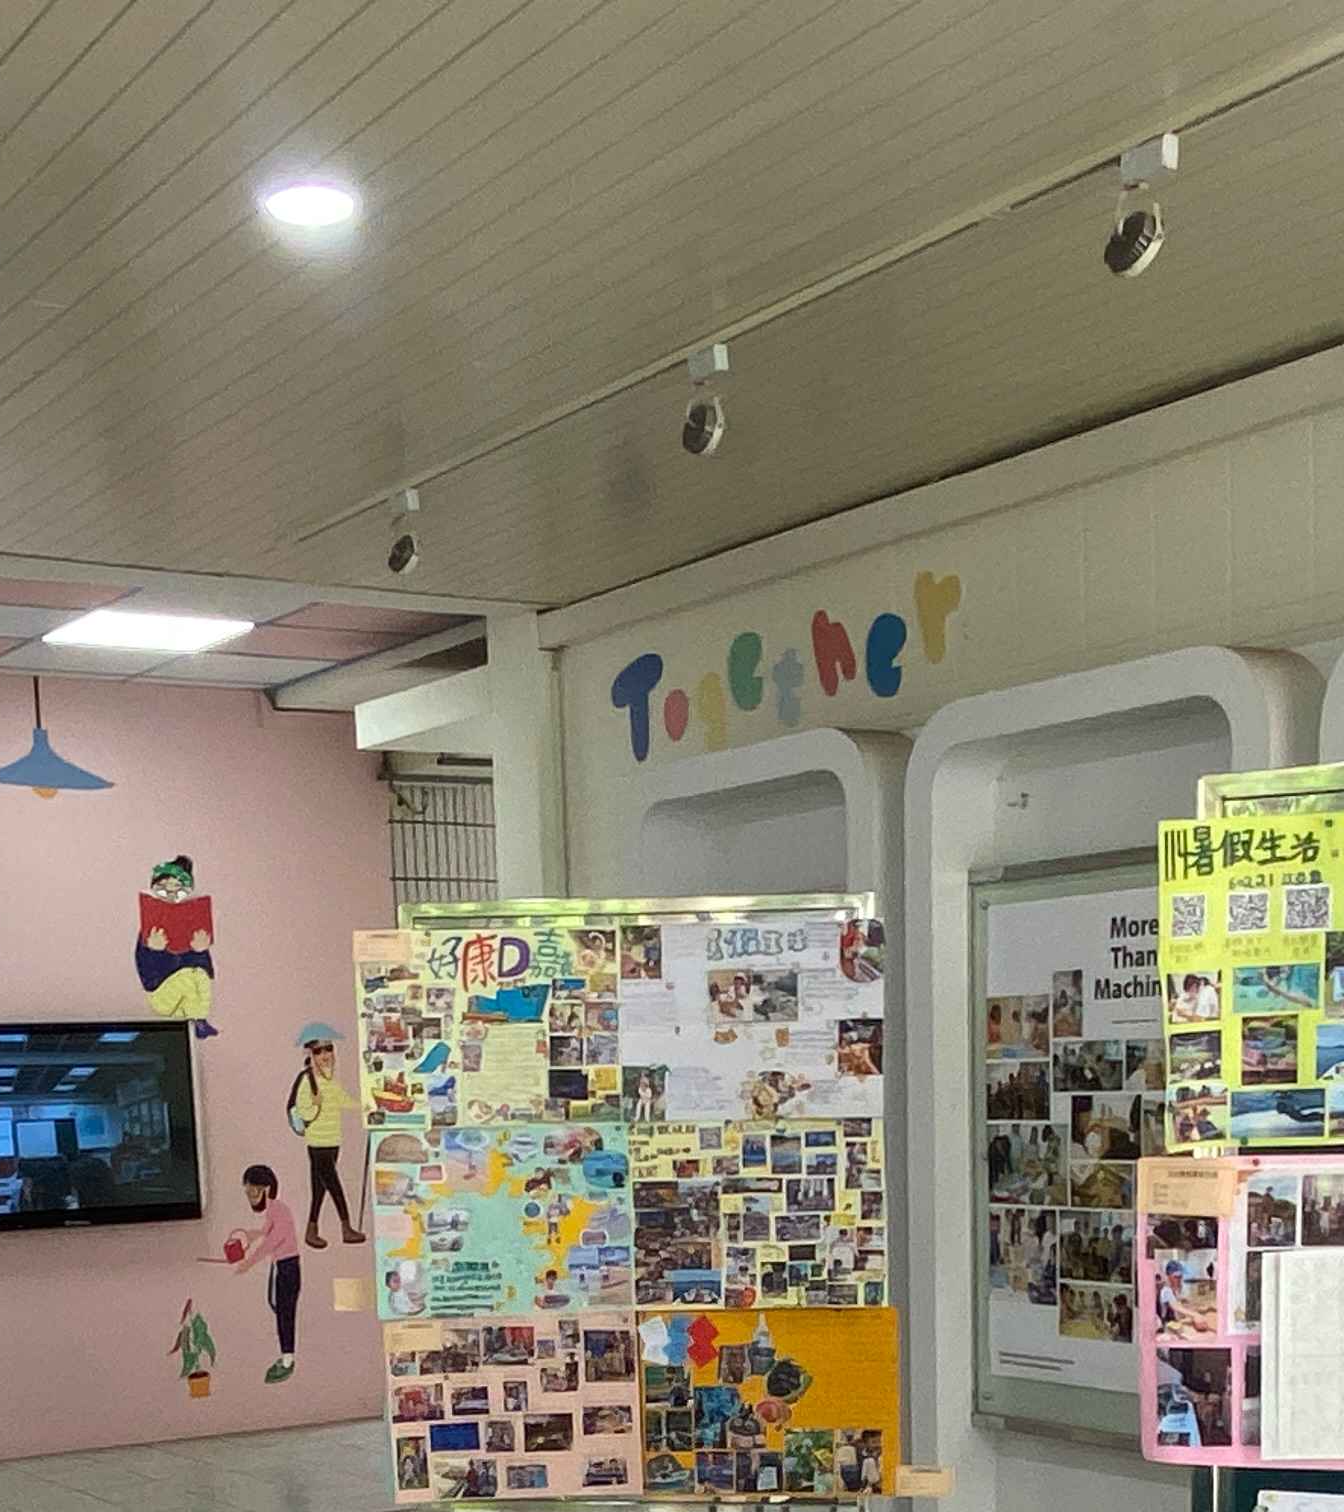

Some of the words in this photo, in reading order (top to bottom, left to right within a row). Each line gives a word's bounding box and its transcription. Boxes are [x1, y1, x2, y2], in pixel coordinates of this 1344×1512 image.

[611, 570, 962, 763] Together
[1163, 825, 1321, 882] 114暑假生活
[1110, 916, 1160, 938] More
[1110, 947, 1158, 969] Than
[1093, 974, 1163, 1000] Machin
